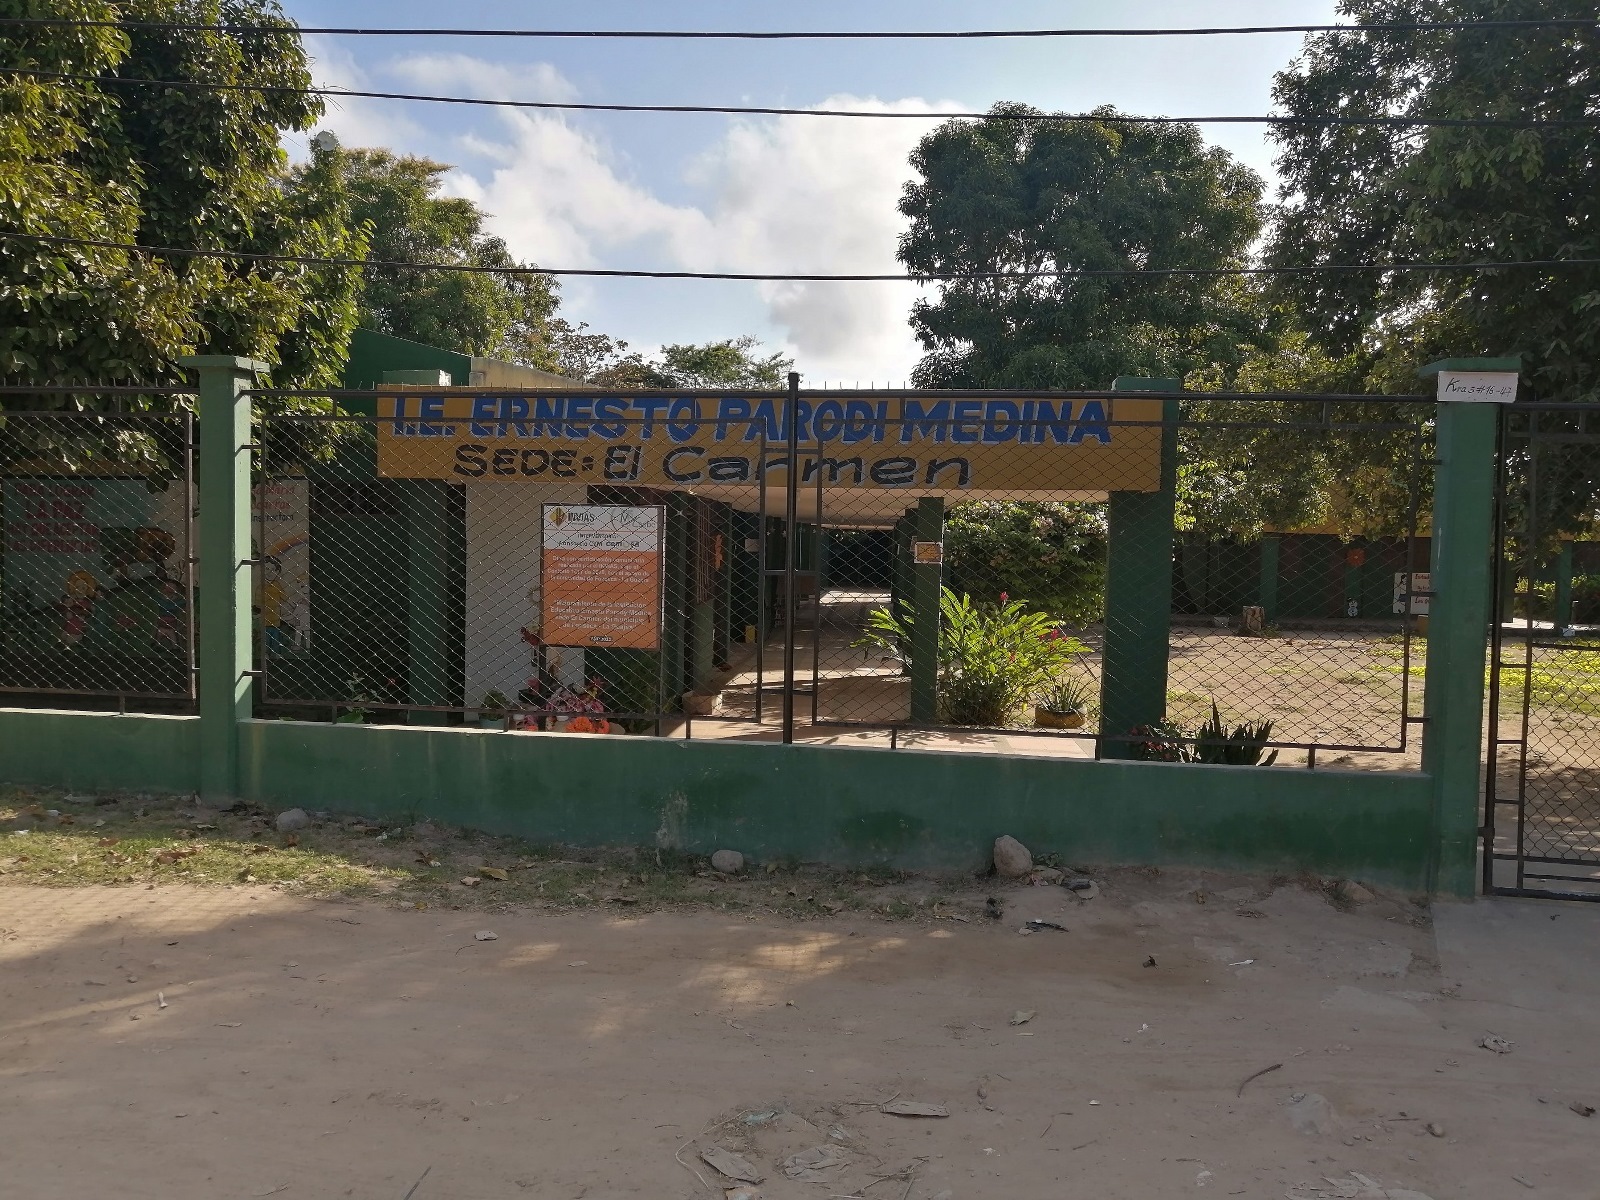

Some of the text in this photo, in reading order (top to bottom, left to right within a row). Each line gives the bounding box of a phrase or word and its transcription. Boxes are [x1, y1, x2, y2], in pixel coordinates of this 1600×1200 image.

[393, 397, 1113, 445] I.E. ERNESTO PARODI MEDINA
[603, 445, 643, 481] El
[662, 446, 971, 487] Carmen
